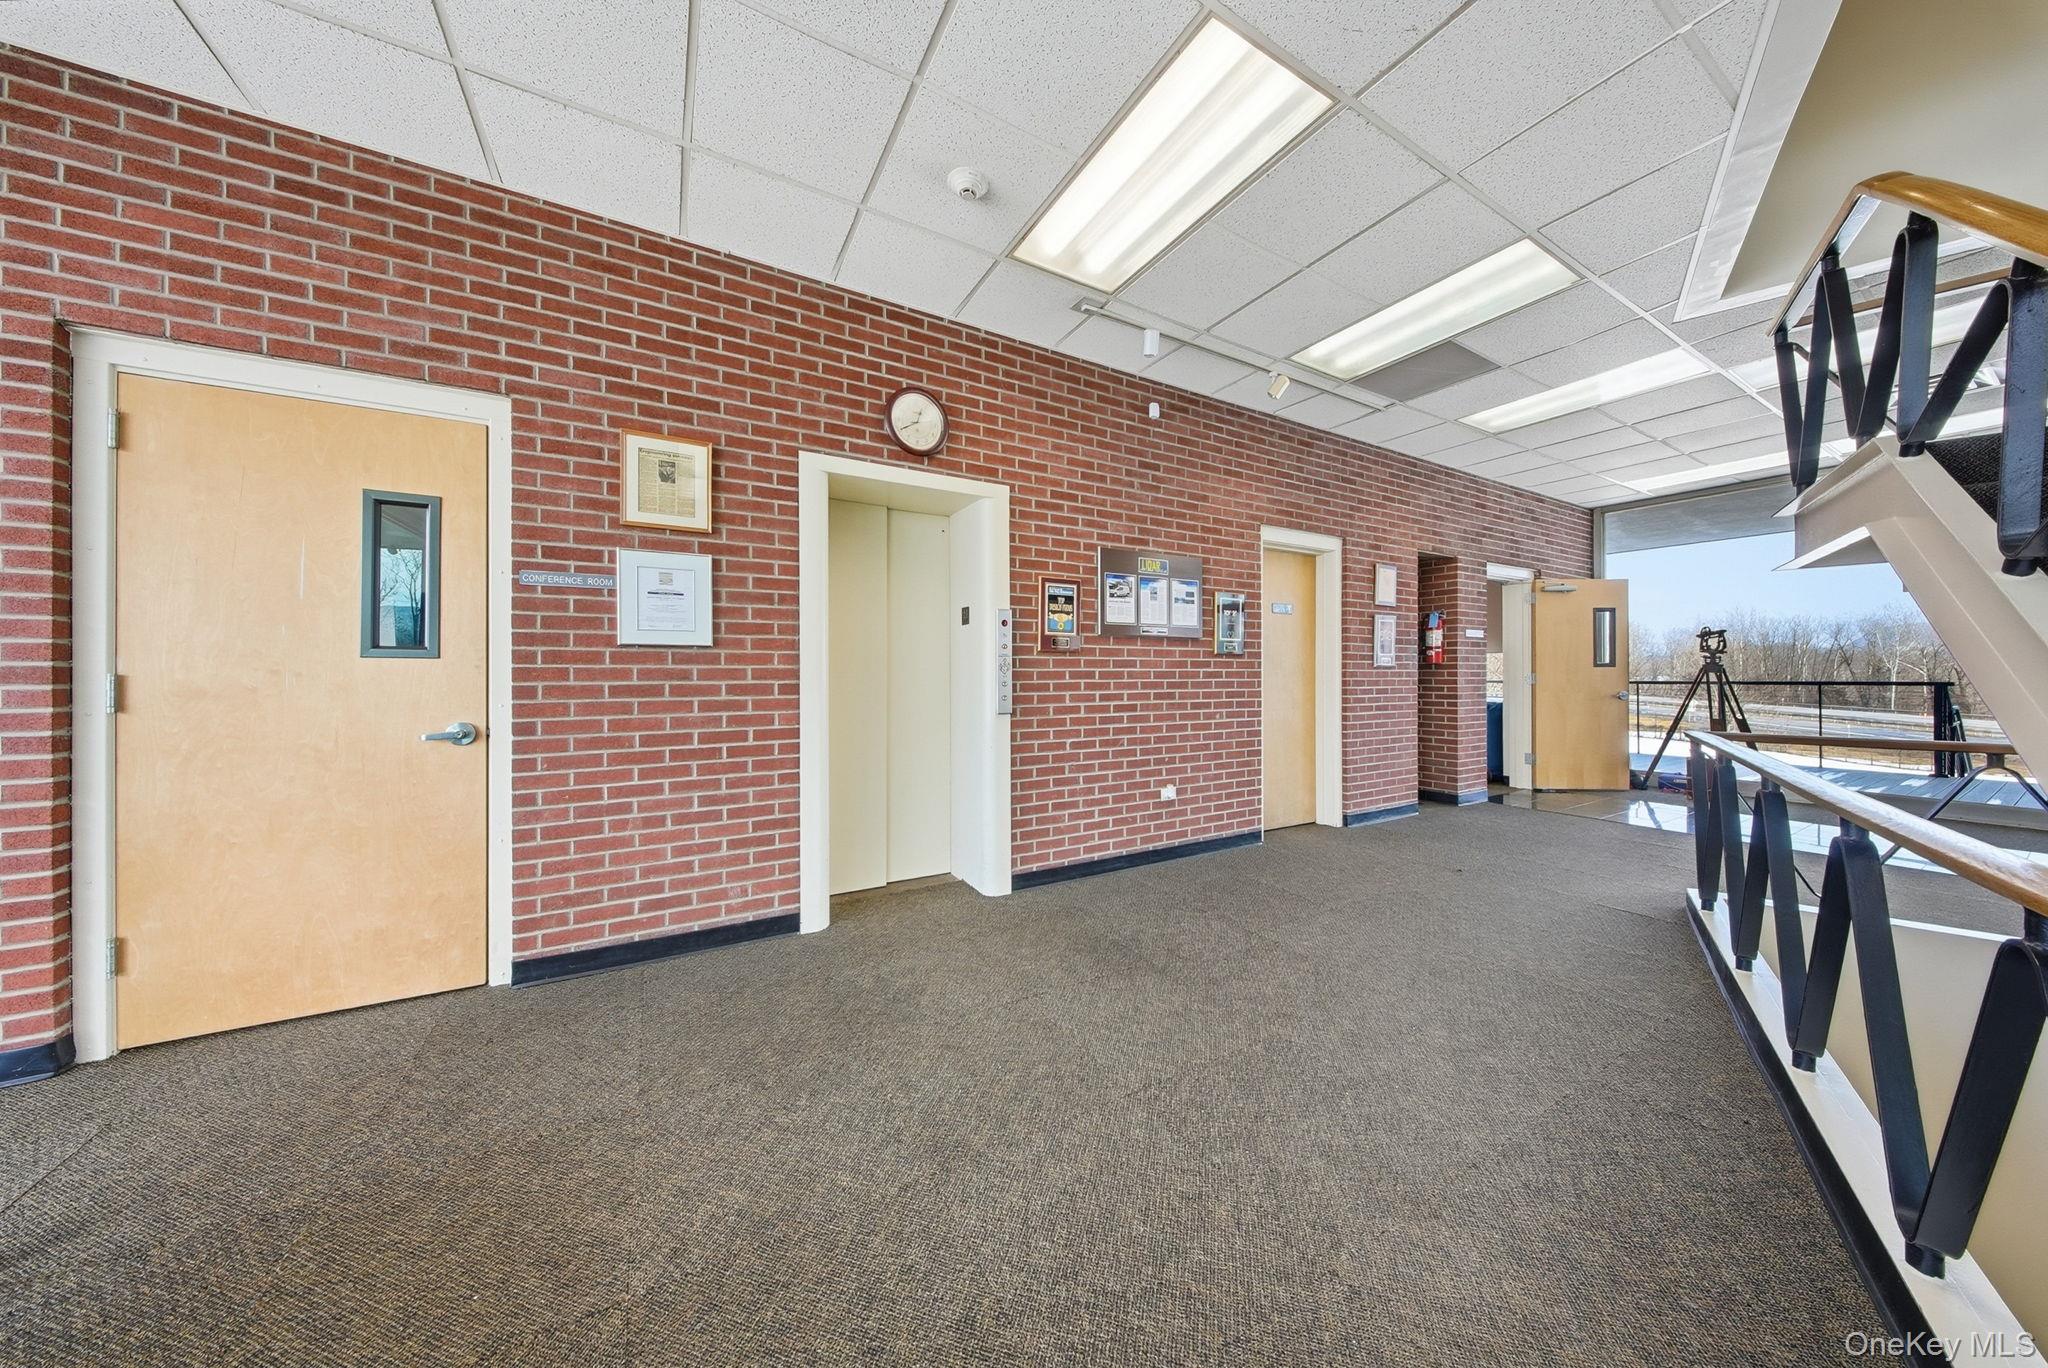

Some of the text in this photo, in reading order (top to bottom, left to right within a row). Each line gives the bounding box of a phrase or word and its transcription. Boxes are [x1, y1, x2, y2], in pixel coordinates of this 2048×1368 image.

[1141, 559, 1161, 572] LIDAR
[522, 574, 613, 586] CONFERENCE ROOM
